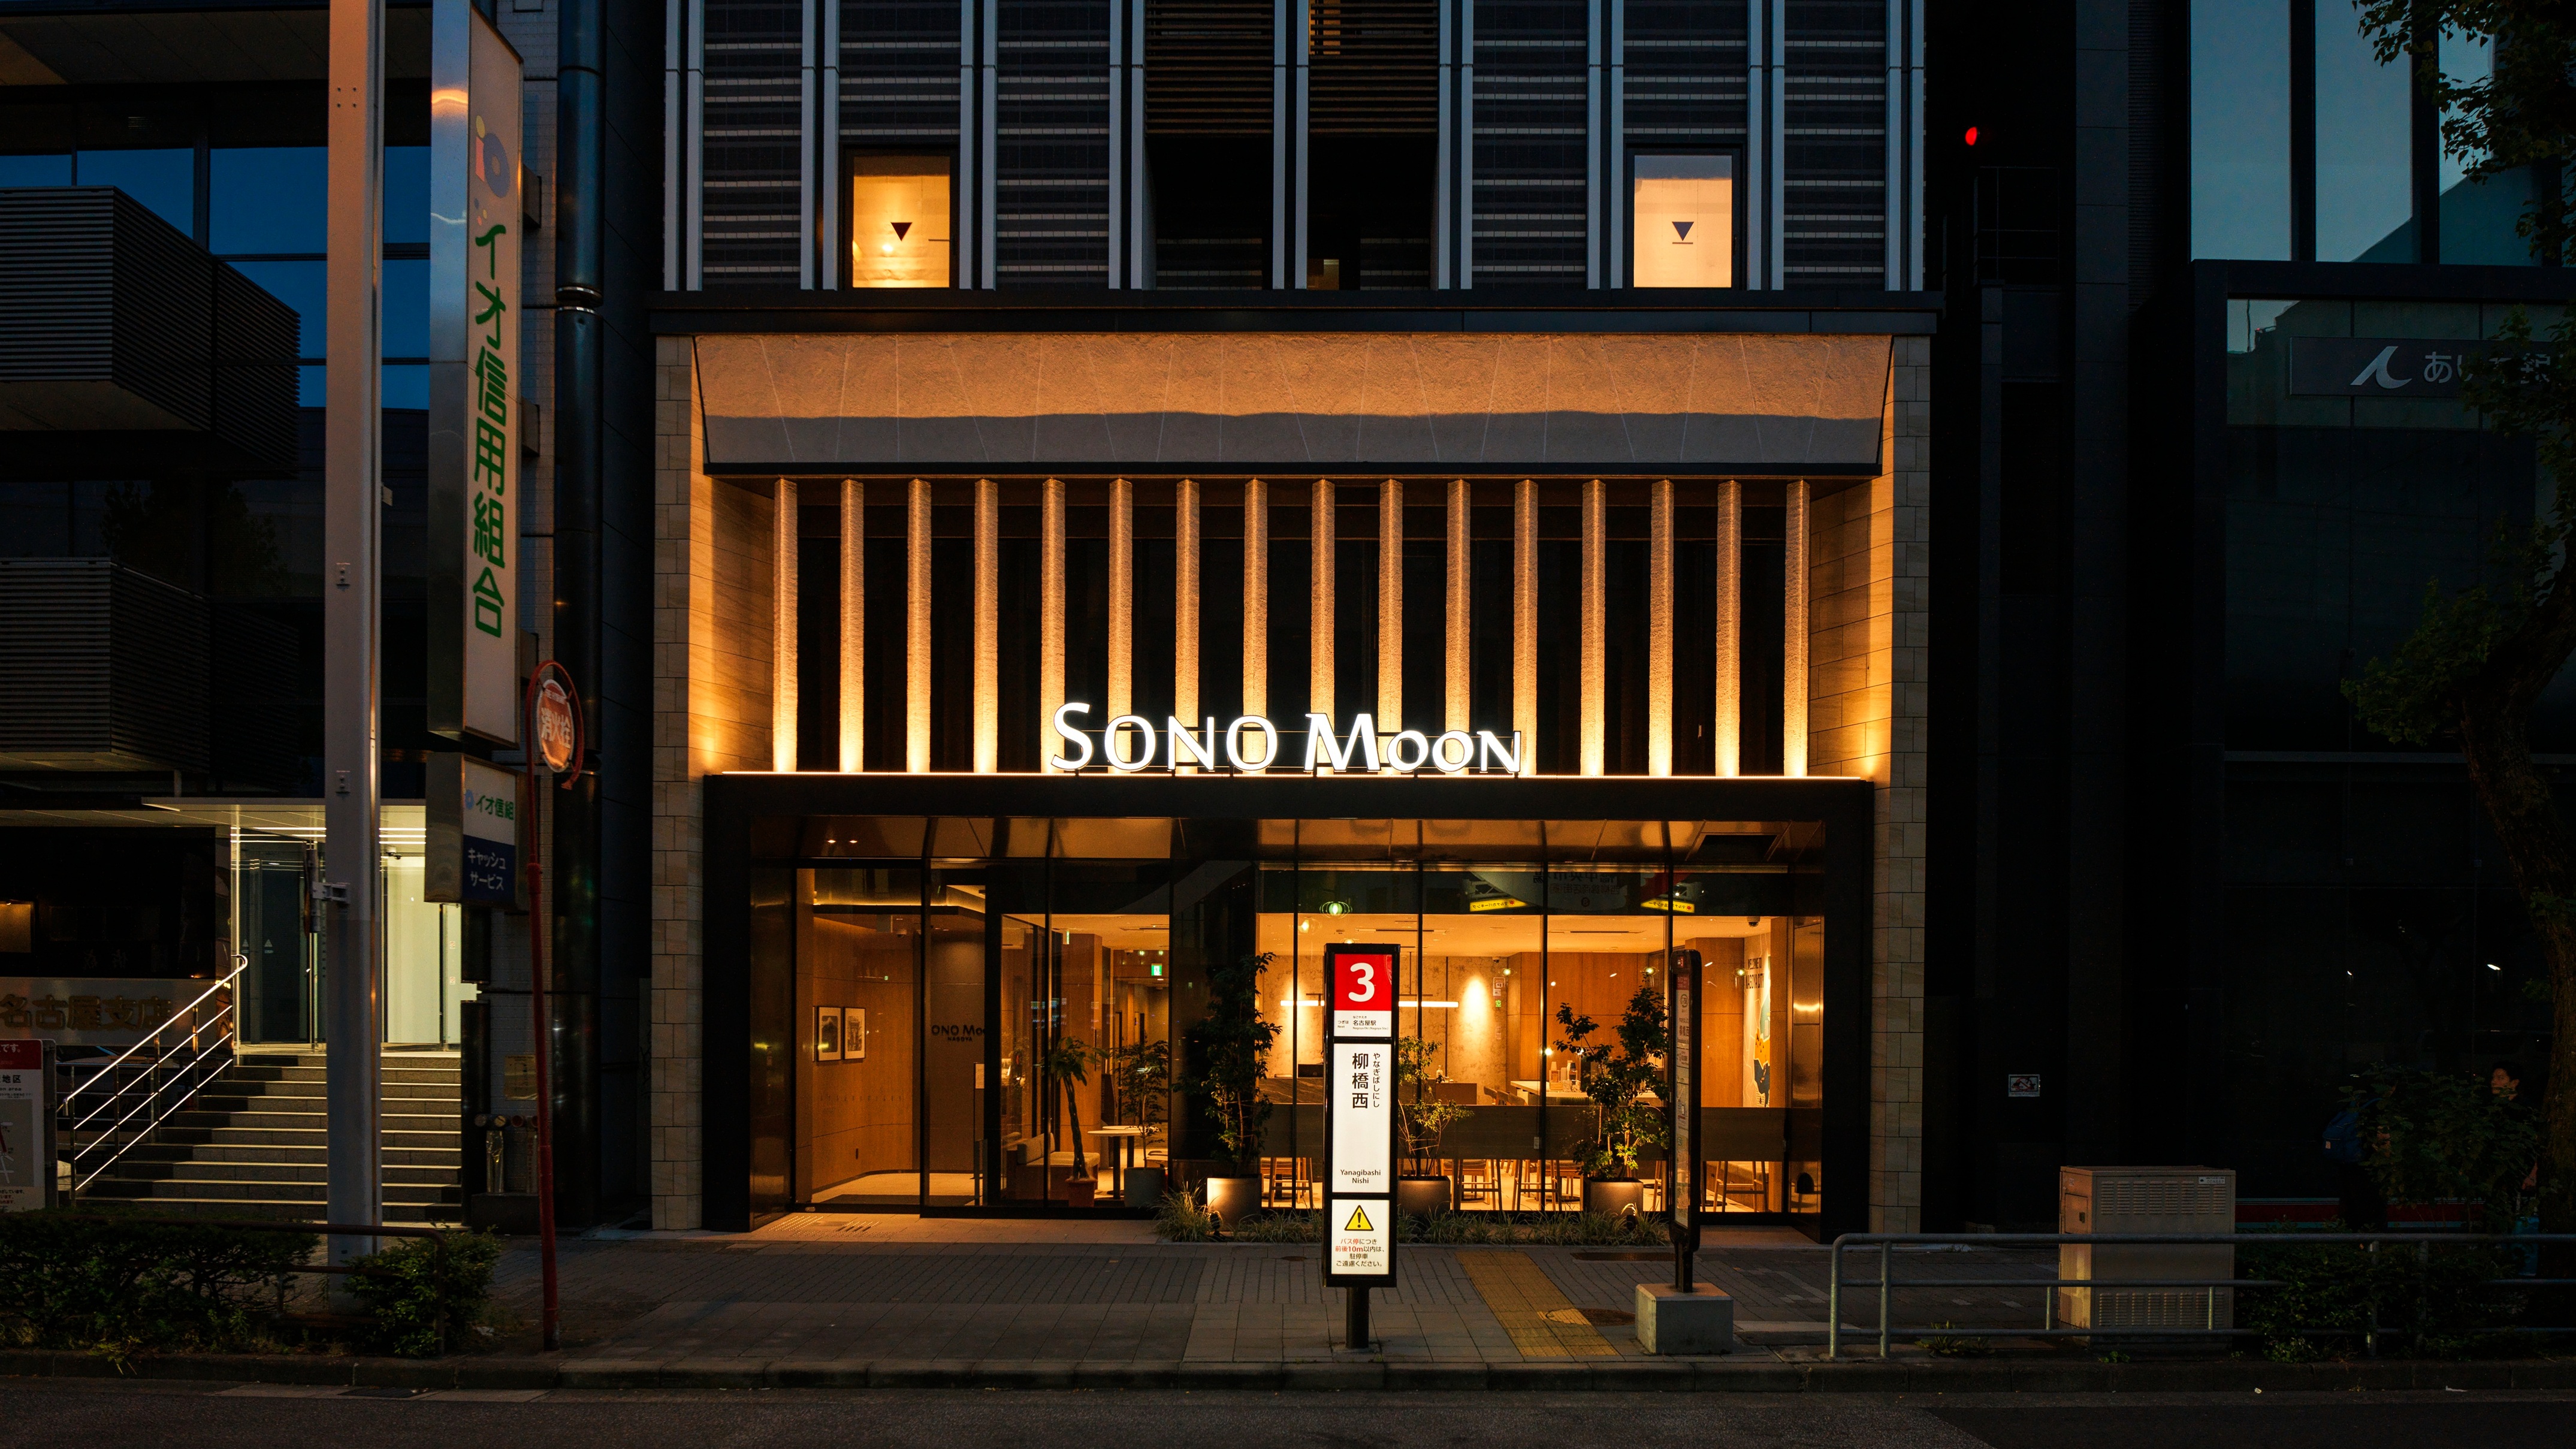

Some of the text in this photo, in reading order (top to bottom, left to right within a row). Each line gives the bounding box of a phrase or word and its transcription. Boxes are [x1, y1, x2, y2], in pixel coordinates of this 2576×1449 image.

[473, 224, 507, 638] イオ信用組合
[541, 707, 571, 748] 消火栓
[1052, 702, 1278, 771] SONO
[476, 795, 514, 820] イオ信組
[467, 847, 506, 870] キャッシュ
[470, 871, 505, 890] サービス
[1348, 962, 1375, 1002] 3
[0, 994, 173, 1030] 名古屋支店
[931, 1025, 959, 1036] ONO
[0, 1043, 20, 1053] です。
[0, 1074, 22, 1083] 地区
[1352, 1053, 1369, 1109] 柳橋西
